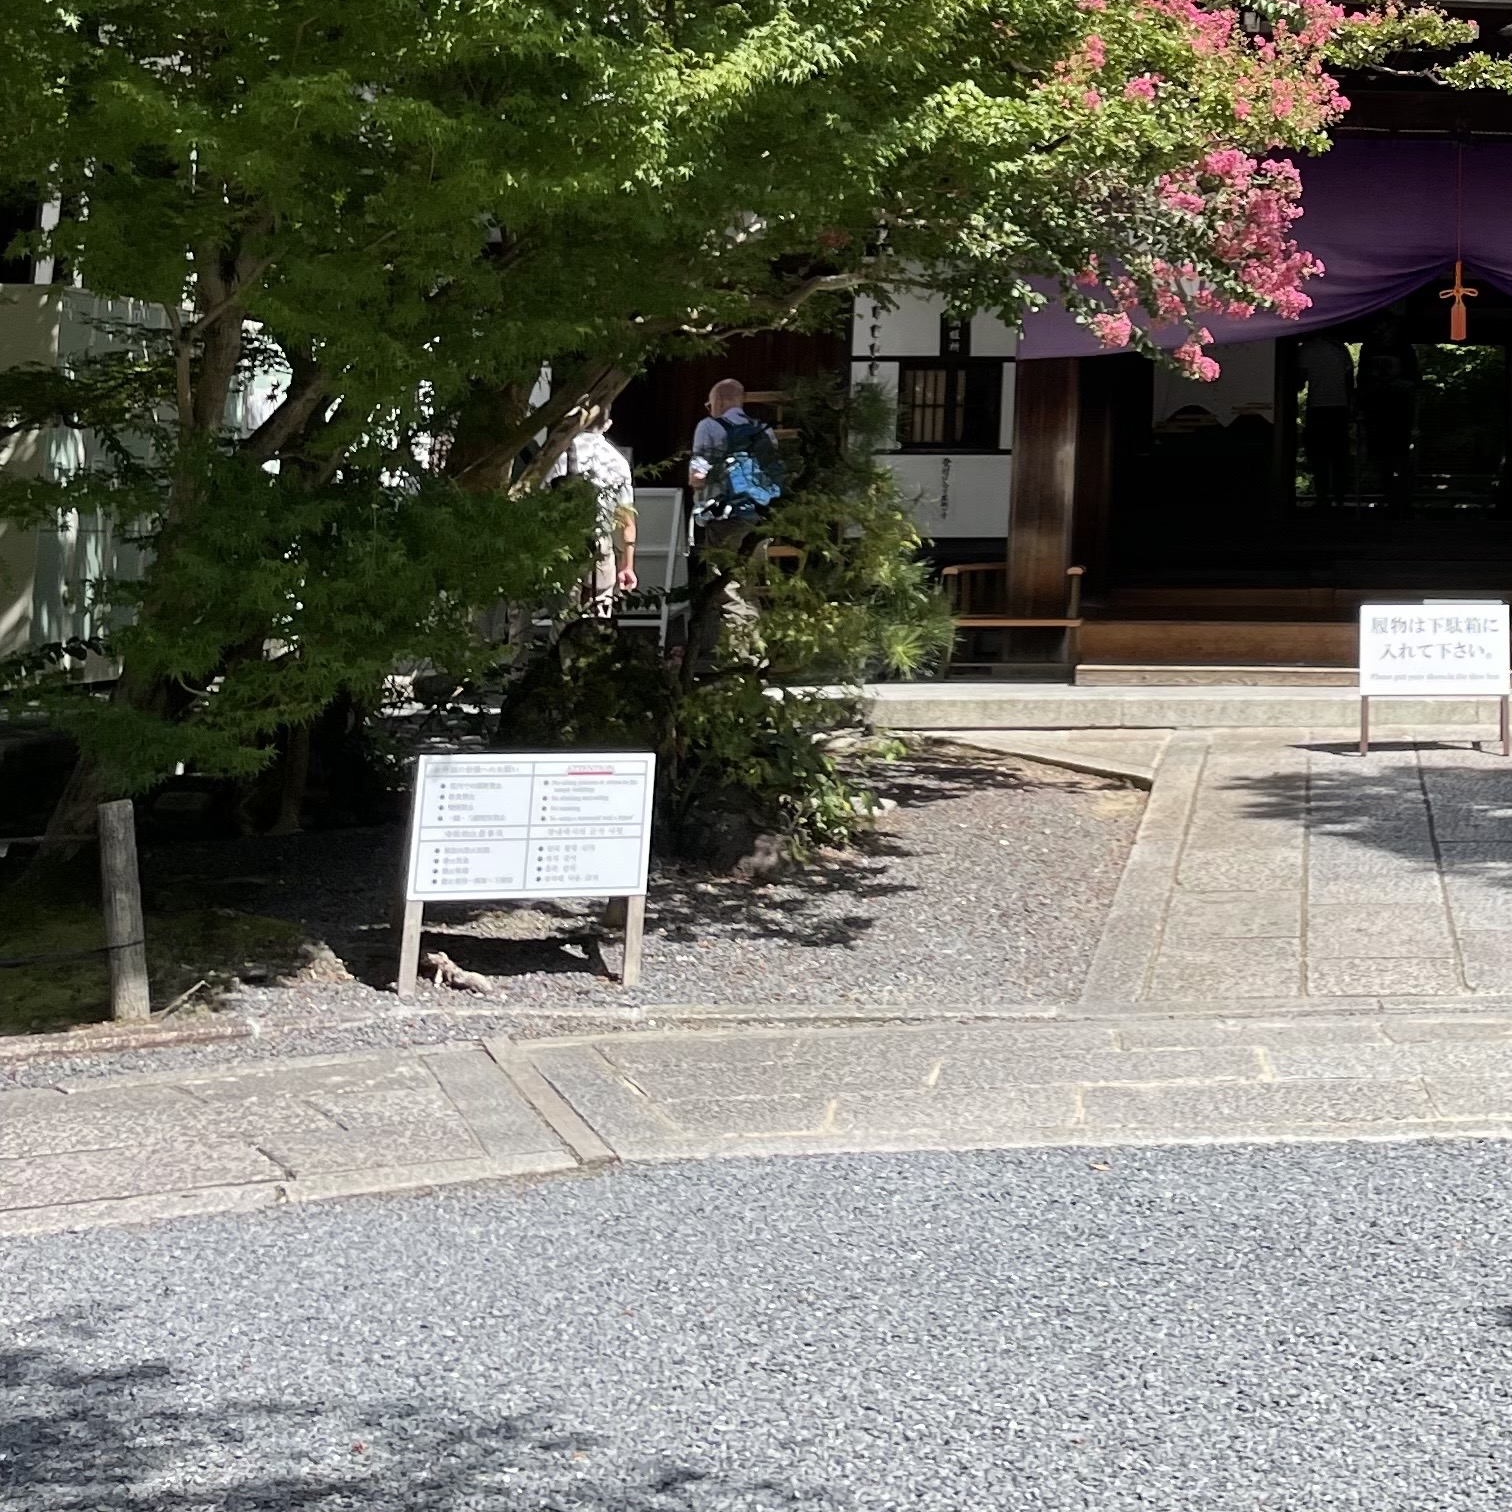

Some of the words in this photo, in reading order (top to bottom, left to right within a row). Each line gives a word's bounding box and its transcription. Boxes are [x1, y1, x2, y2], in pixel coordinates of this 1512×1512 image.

[1371, 617, 1499, 634] 履物は下駄箱に
[1379, 642, 1493, 660] 入れて下さい。
